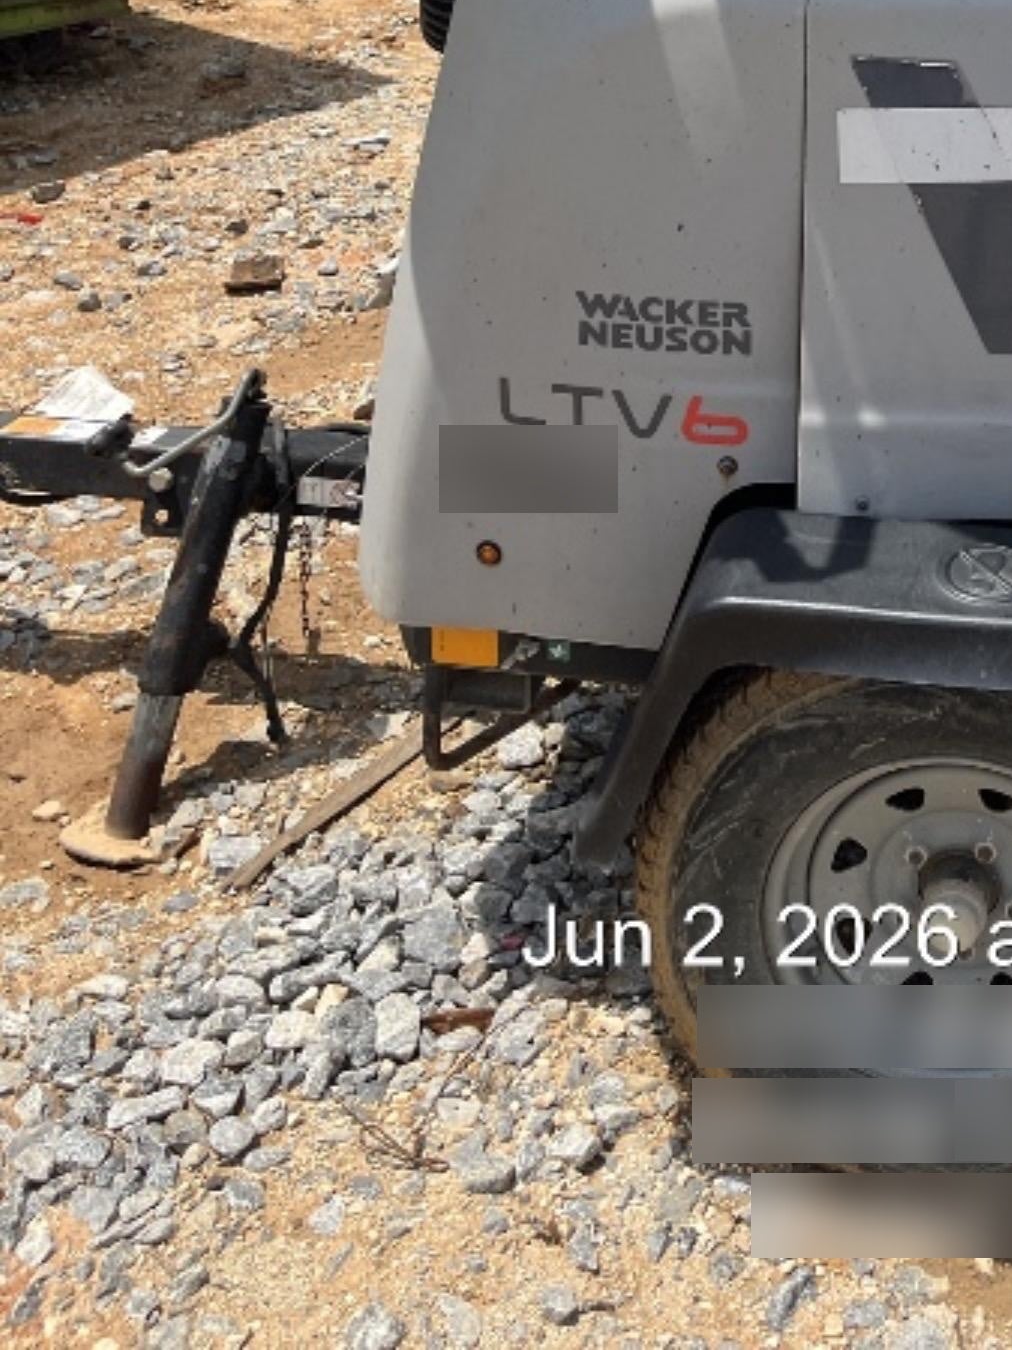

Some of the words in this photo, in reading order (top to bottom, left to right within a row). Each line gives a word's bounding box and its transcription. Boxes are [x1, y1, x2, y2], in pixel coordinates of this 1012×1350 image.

[575, 290, 752, 328] WACKER
[578, 321, 752, 356] NEUSON
[499, 376, 750, 446] LTV6
